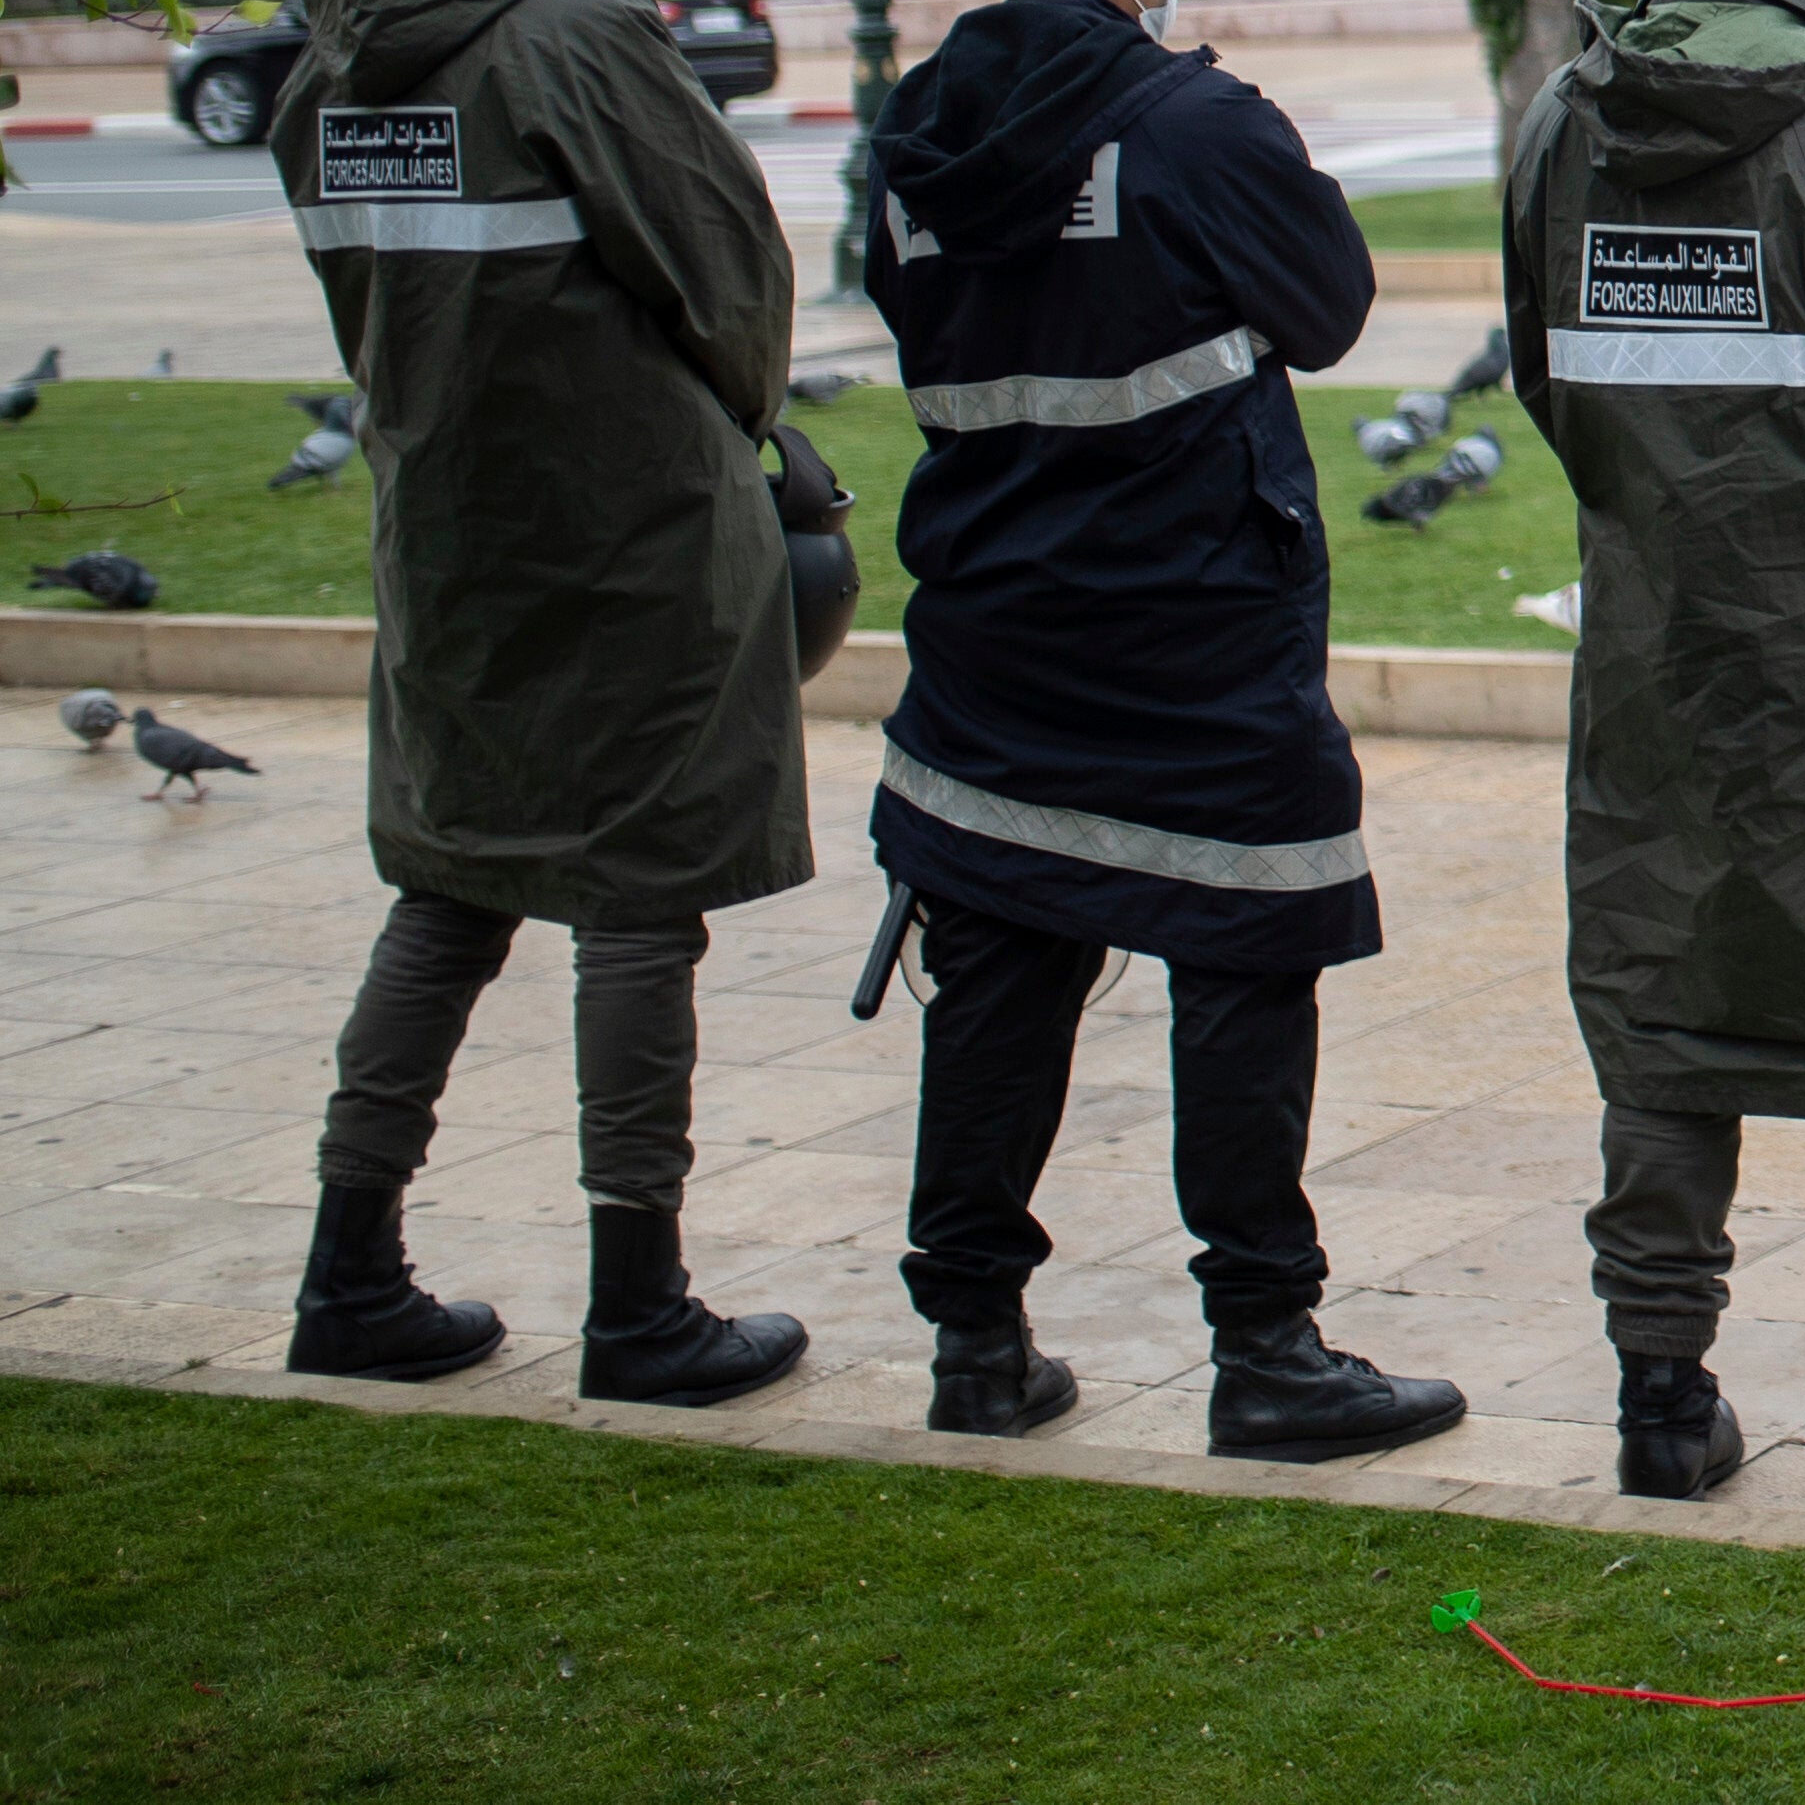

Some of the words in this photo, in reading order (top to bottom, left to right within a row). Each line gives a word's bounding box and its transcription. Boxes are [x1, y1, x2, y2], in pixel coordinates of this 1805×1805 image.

[326, 120, 393, 148] المساعدة
[394, 120, 452, 154] القوات
[326, 158, 368, 186] FORCES
[368, 158, 454, 185] AUXILIAIRES
[1593, 238, 1689, 272] المساعدة
[1691, 243, 1753, 281] القوات
[1591, 281, 1657, 312] FORCES
[1658, 284, 1757, 316] AUXILIAIRES
